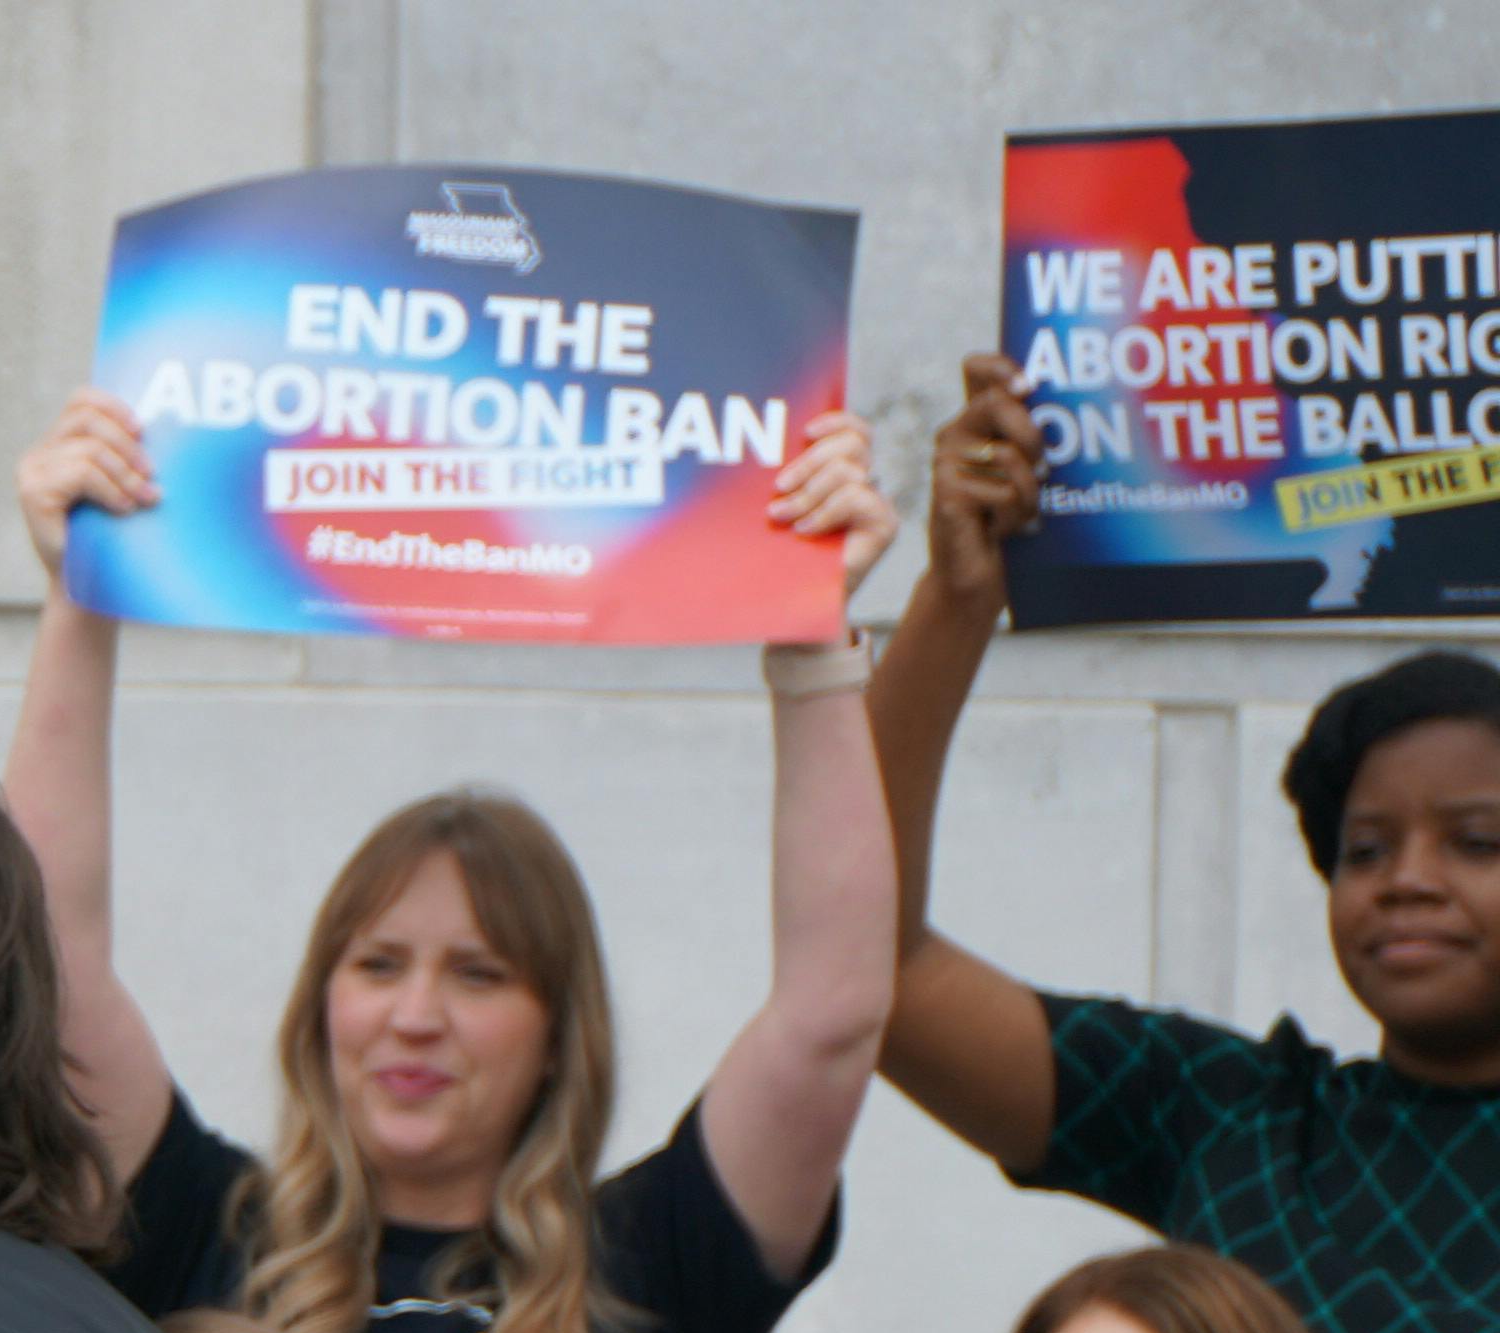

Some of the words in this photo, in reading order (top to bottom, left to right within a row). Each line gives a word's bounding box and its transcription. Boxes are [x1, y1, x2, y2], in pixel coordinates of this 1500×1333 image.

[1026, 248, 1124, 316] WE
[1140, 243, 1278, 314] ARE
[286, 283, 468, 361] END
[485, 295, 653, 375] THE
[1021, 315, 1382, 392] ABORTION
[135, 358, 585, 450] ABORTION
[606, 384, 787, 467] BAN
[1029, 401, 1132, 466] ON
[1145, 397, 1284, 461] THE
[288, 461, 387, 502] JOIN
[404, 460, 490, 494] THE
[508, 457, 637, 494] FIGHT
[1297, 477, 1380, 523] JOIN
[1396, 459, 1470, 500] THE
[306, 525, 593, 578] #EndTheBanMO
